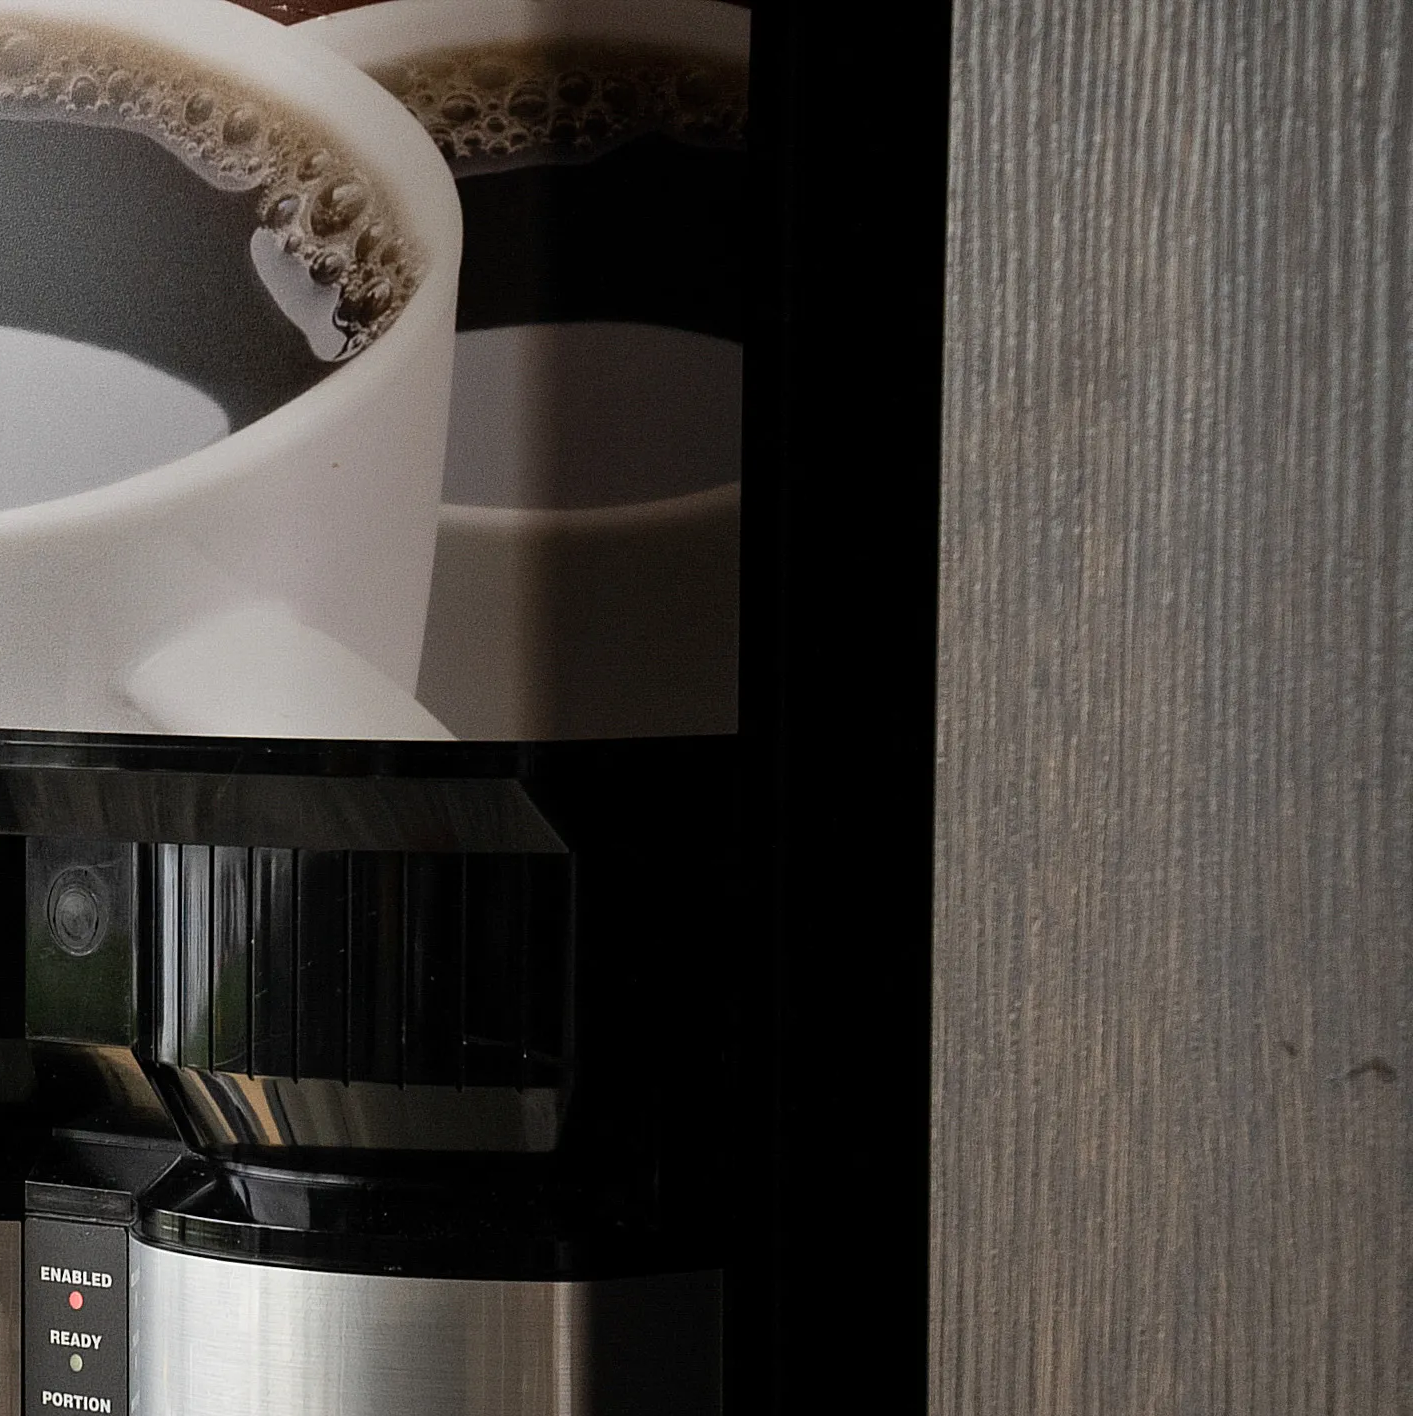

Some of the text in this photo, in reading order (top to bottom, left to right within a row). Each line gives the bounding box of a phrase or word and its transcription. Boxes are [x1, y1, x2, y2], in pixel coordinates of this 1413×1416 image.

[40, 1265, 113, 1288] ENABLED
[49, 1329, 103, 1351] READY
[41, 1390, 112, 1414] PORTION
